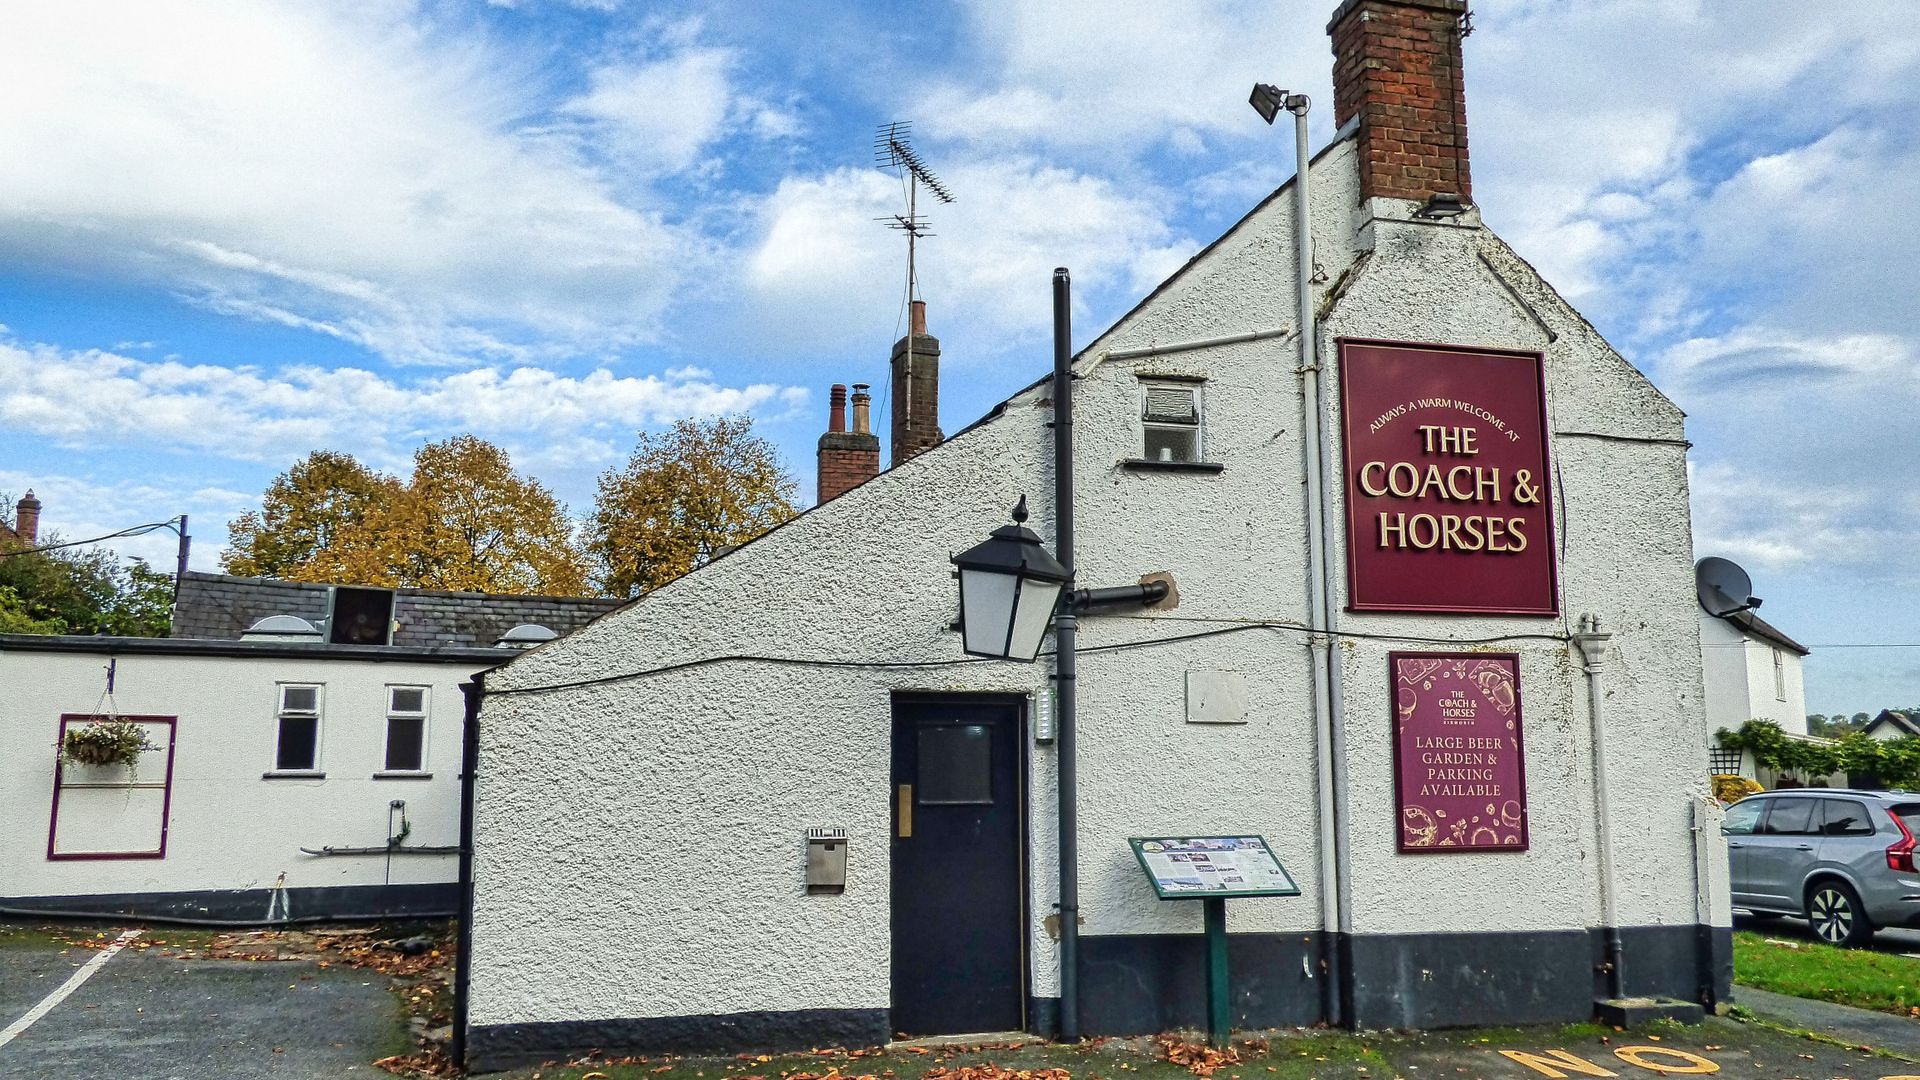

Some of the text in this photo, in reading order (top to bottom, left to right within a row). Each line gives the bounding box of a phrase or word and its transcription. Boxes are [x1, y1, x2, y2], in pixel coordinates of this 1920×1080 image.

[1369, 398, 1521, 443] ALWAYS A WARM WELCOME AT
[1419, 425, 1479, 454] THE
[1361, 461, 1540, 503] COACH &
[1379, 512, 1528, 552] HORSES
[1451, 690, 1465, 698] THE
[1438, 698, 1478, 708] COACH &
[1442, 708, 1476, 718] HORSES
[1416, 736, 1503, 750] LARGE BEER
[1422, 752, 1498, 765] GARDEN &
[1428, 768, 1493, 781] PARKING
[1420, 784, 1501, 796] AVAILABLE
[1498, 1045, 1720, 1079] NO
